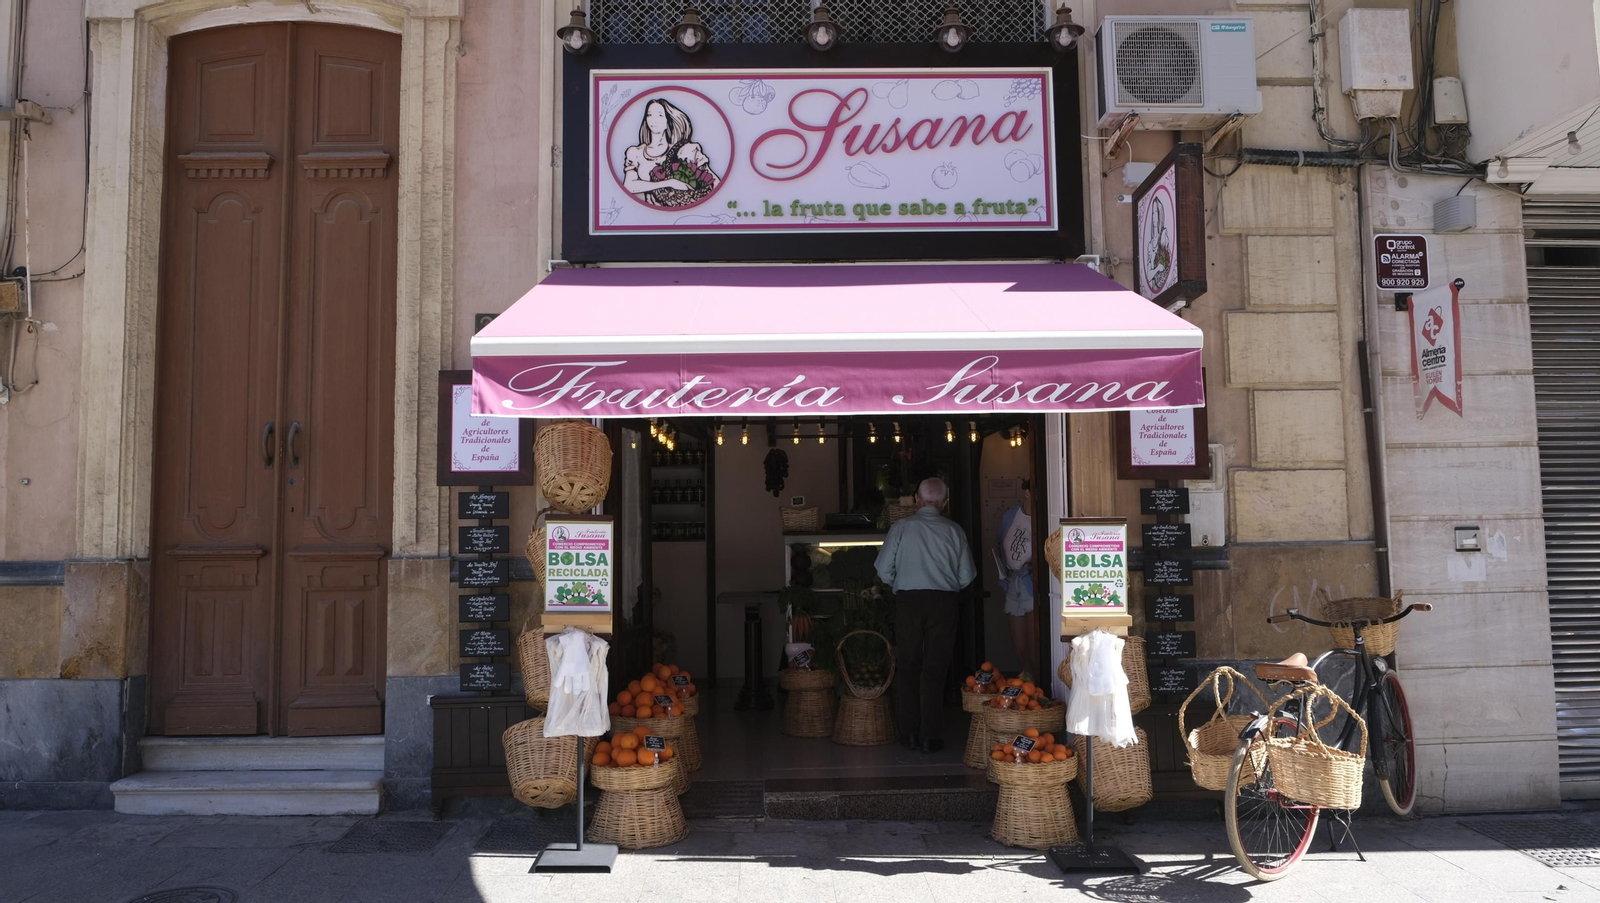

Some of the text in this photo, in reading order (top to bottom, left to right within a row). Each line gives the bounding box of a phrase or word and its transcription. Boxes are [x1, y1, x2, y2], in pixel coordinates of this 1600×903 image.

[749, 87, 1033, 181] Susana
[763, 199, 783, 217] la
[790, 199, 846, 217] fruta
[852, 203, 891, 221] que
[897, 198, 944, 216] sabe
[953, 202, 967, 216] a
[1422, 345, 1446, 359] Almería
[1422, 355, 1446, 367] centro
[502, 355, 1174, 410] Frutería Susana
[463, 428, 508, 437] Agricultores
[1140, 424, 1185, 432] Agricultores
[461, 436, 511, 444] Tradicionales
[1150, 449, 1177, 457] España
[472, 454, 499, 463] España
[575, 530, 605, 538] Susana
[1090, 532, 1120, 540] Susana
[549, 552, 608, 566] BOLSA
[1065, 554, 1123, 567] BOLSA
[549, 569, 608, 577] RECICLADA
[1065, 570, 1123, 578] RECICLADA
